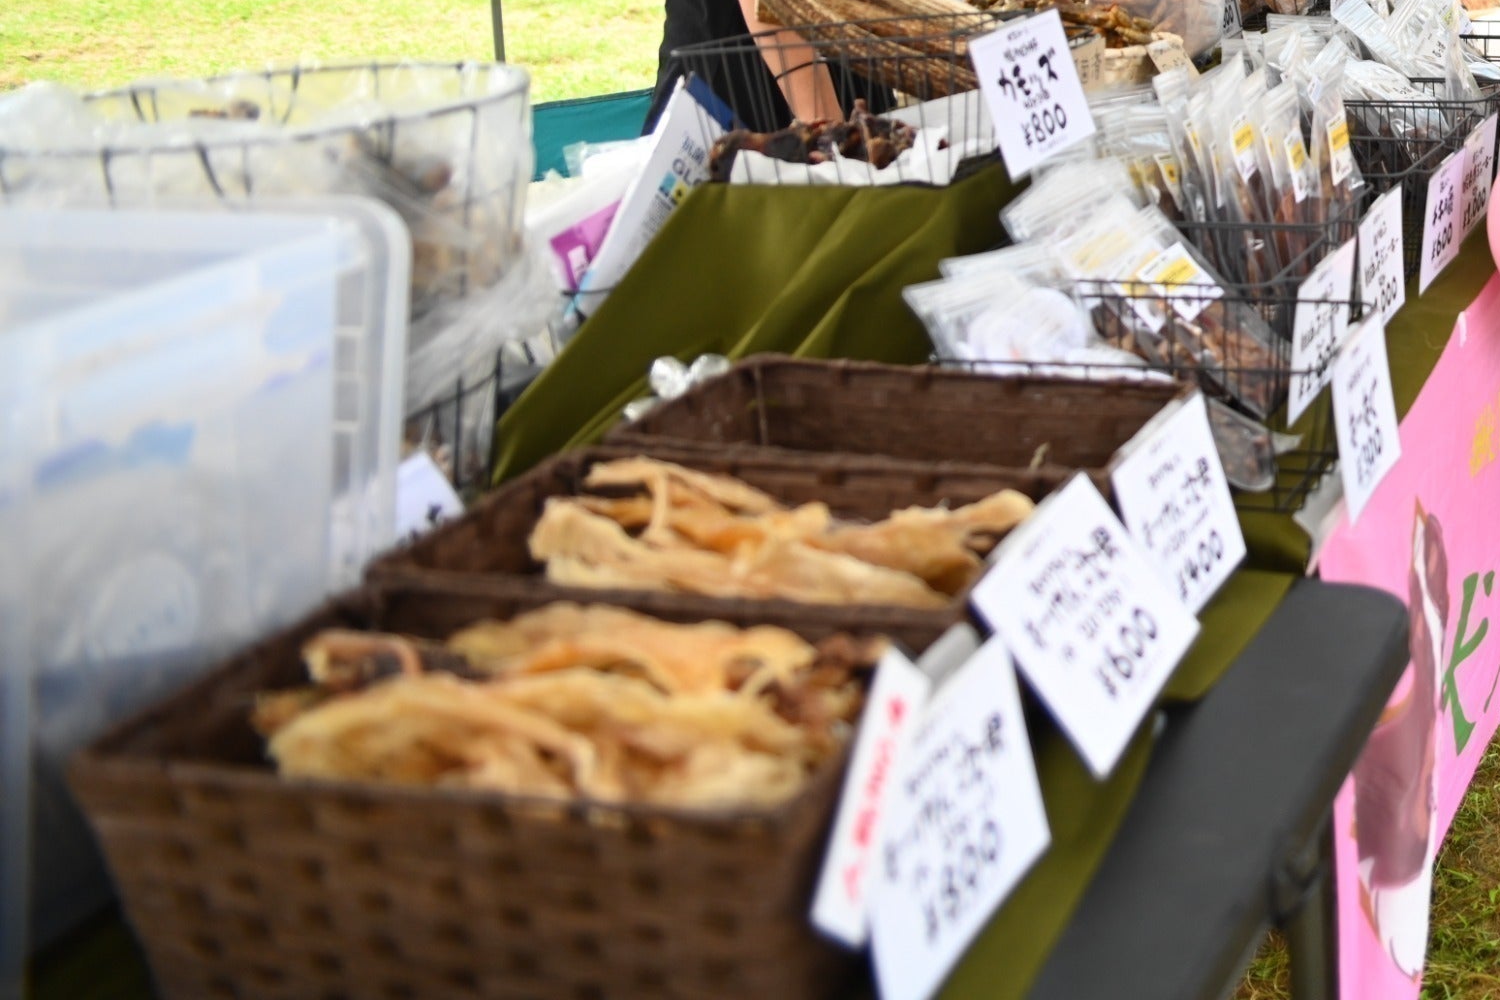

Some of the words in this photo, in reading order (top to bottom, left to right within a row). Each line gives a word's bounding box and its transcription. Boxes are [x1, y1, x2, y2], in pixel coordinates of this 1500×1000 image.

[1021, 102, 1068, 148] ¥800
[1431, 221, 1454, 261] ¥600
[1094, 606, 1159, 701] ¥600
